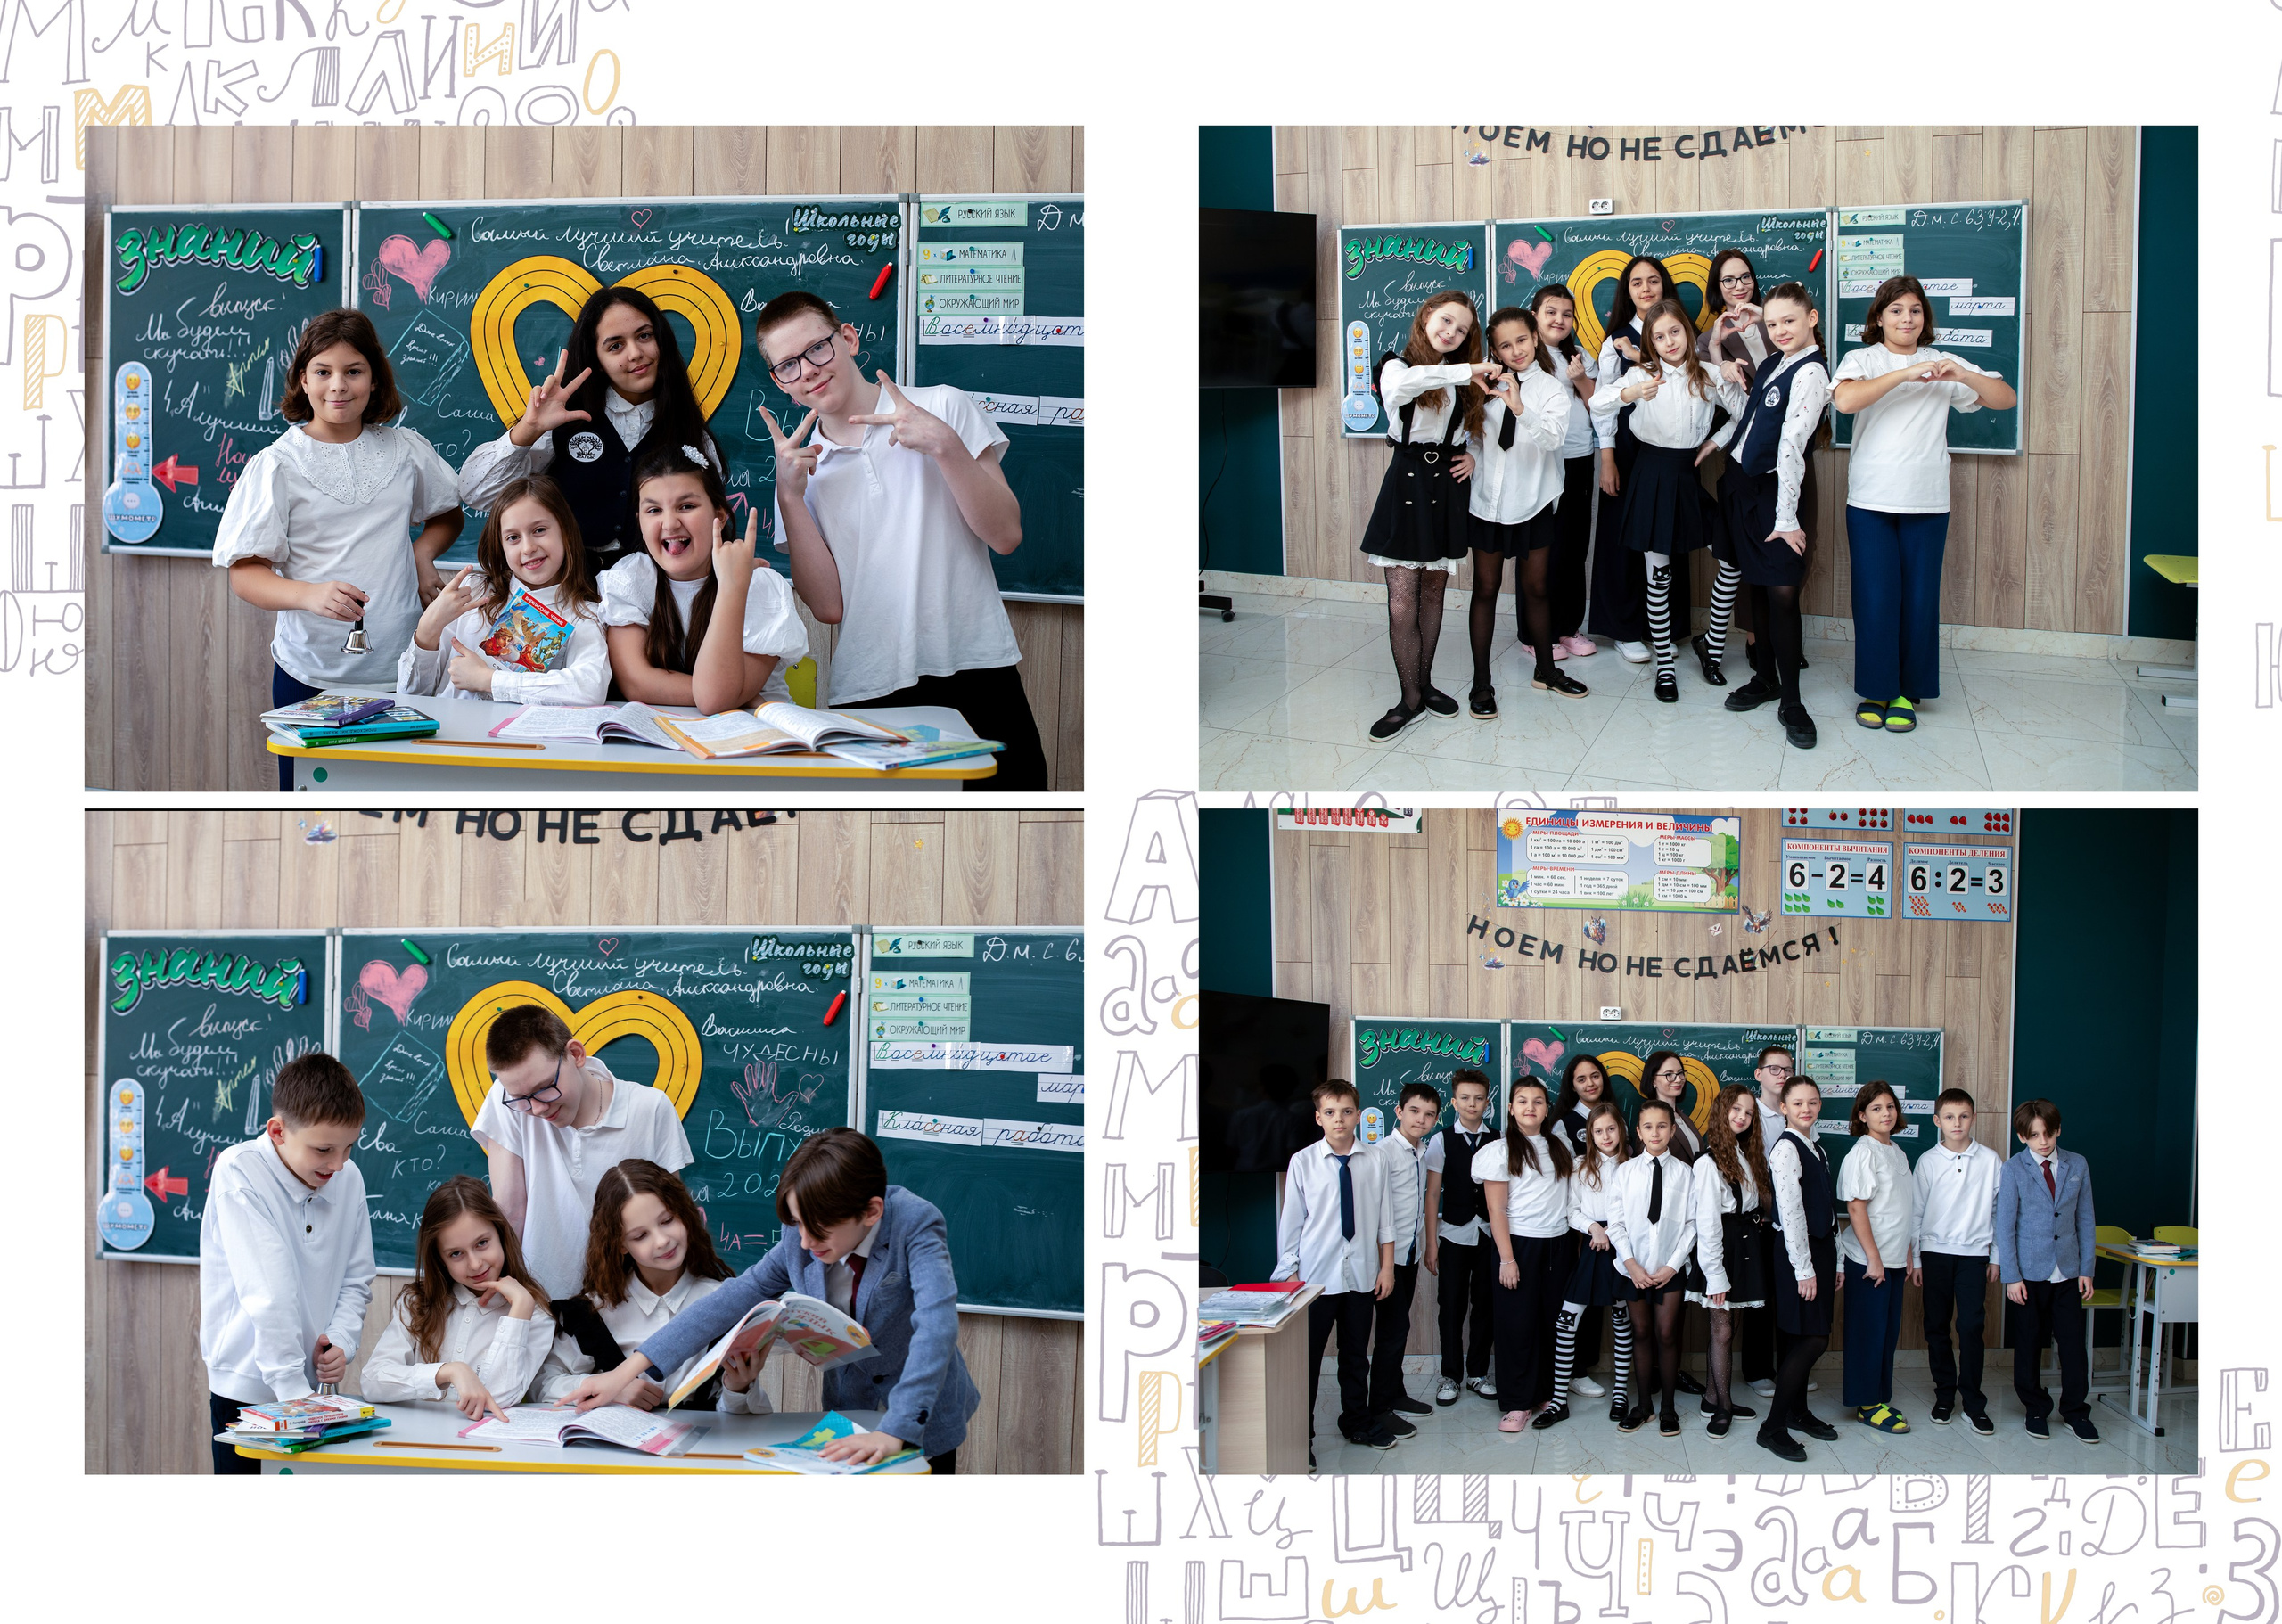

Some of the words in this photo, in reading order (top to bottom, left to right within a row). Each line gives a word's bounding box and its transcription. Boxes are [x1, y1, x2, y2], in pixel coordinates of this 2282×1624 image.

[1566, 135, 1611, 160] НО
[1621, 136, 1662, 162] НЕ
[794, 208, 899, 232] Школьные
[958, 207, 992, 219] РУССКИЙ
[995, 209, 1016, 219] ЯЗЫК
[1761, 216, 1827, 231] Школьные
[1862, 214, 1884, 222] РУССКИЙ
[471, 216, 550, 242] Самый
[556, 226, 663, 250] лучший
[847, 233, 895, 253] годы
[1616, 230, 1686, 250] лучший
[1794, 230, 1826, 242] годы
[115, 223, 317, 296] знаний
[959, 249, 1007, 259] МАТЕМАТИКА
[1344, 234, 1471, 280] знаний
[1851, 253, 1885, 261] ЛИТЕРАТУРНОЕ
[939, 274, 993, 284] ЛИТЕРАТУРНОЕ
[996, 274, 1022, 284] ЧТЕНИЕ
[1851, 268, 1889, 276] ОКРУЖАЮЩИЙ
[939, 298, 1000, 309] ОКРУЖАЮЩИЙ
[1003, 299, 1020, 308] МИР
[176, 297, 250, 346] будем
[437, 393, 497, 423] Саша
[107, 514, 158, 524] ШУМОМЕТР
[524, 595, 550, 616] ВНЕКЛАССНОЕ
[550, 613, 564, 627] ЧТЕНИЕ
[456, 811, 522, 841] НО
[537, 811, 601, 845] НЕ
[1525, 816, 1579, 827] ЕДИНИЦЫ
[1581, 818, 1643, 830] ИЗМЕРЕНИЯ
[1646, 821, 1654, 830] И
[1656, 822, 1713, 832] ВЕЛИЧИНЫ
[1787, 843, 1841, 852] КОМПОНЕНТЫ
[1842, 845, 1888, 854] ВЫЧИТАНИЯ
[1909, 847, 1966, 857] КОМПОНЕНТЫ
[1789, 862, 1806, 888] 6
[1829, 863, 1846, 889] 2
[1868, 865, 1885, 890] 4
[1910, 866, 1927, 891] 6
[1950, 867, 1966, 892] 2
[1988, 869, 2004, 894] 3
[751, 937, 853, 961] Школьные
[907, 939, 941, 950] РУССКИЙ
[943, 940, 964, 950] ЯЗЫК
[1467, 915, 1564, 964] НОЕМ
[1578, 948, 1618, 973] НО
[1626, 956, 1662, 978] НЕ
[447, 942, 522, 969] Самый
[527, 953, 628, 976] лучший
[801, 961, 848, 981] годы
[111, 947, 302, 1016] знаний
[908, 979, 954, 988] МАТЕМАТИКА
[890, 1002, 941, 1013] ЛИТЕРАТУРНОЕ
[943, 1002, 968, 1013] ЧТЕНИЕ
[168, 1017, 238, 1064] будем
[889, 1024, 947, 1036] ОКРУЖАЮЩИЙ
[949, 1025, 965, 1035] МИР
[1745, 1029, 1798, 1043] Школьные
[723, 1042, 839, 1066] ЧУДЕСНЫ
[875, 1041, 1053, 1070] Восемнадцатое
[1359, 1028, 1487, 1070] знаний
[414, 1111, 470, 1140] Саша
[882, 1111, 981, 1136] Классная
[357, 1121, 402, 1153] Ева
[391, 1144, 446, 1179] КТО?
[103, 1220, 149, 1232] ШУМОМЕТР
